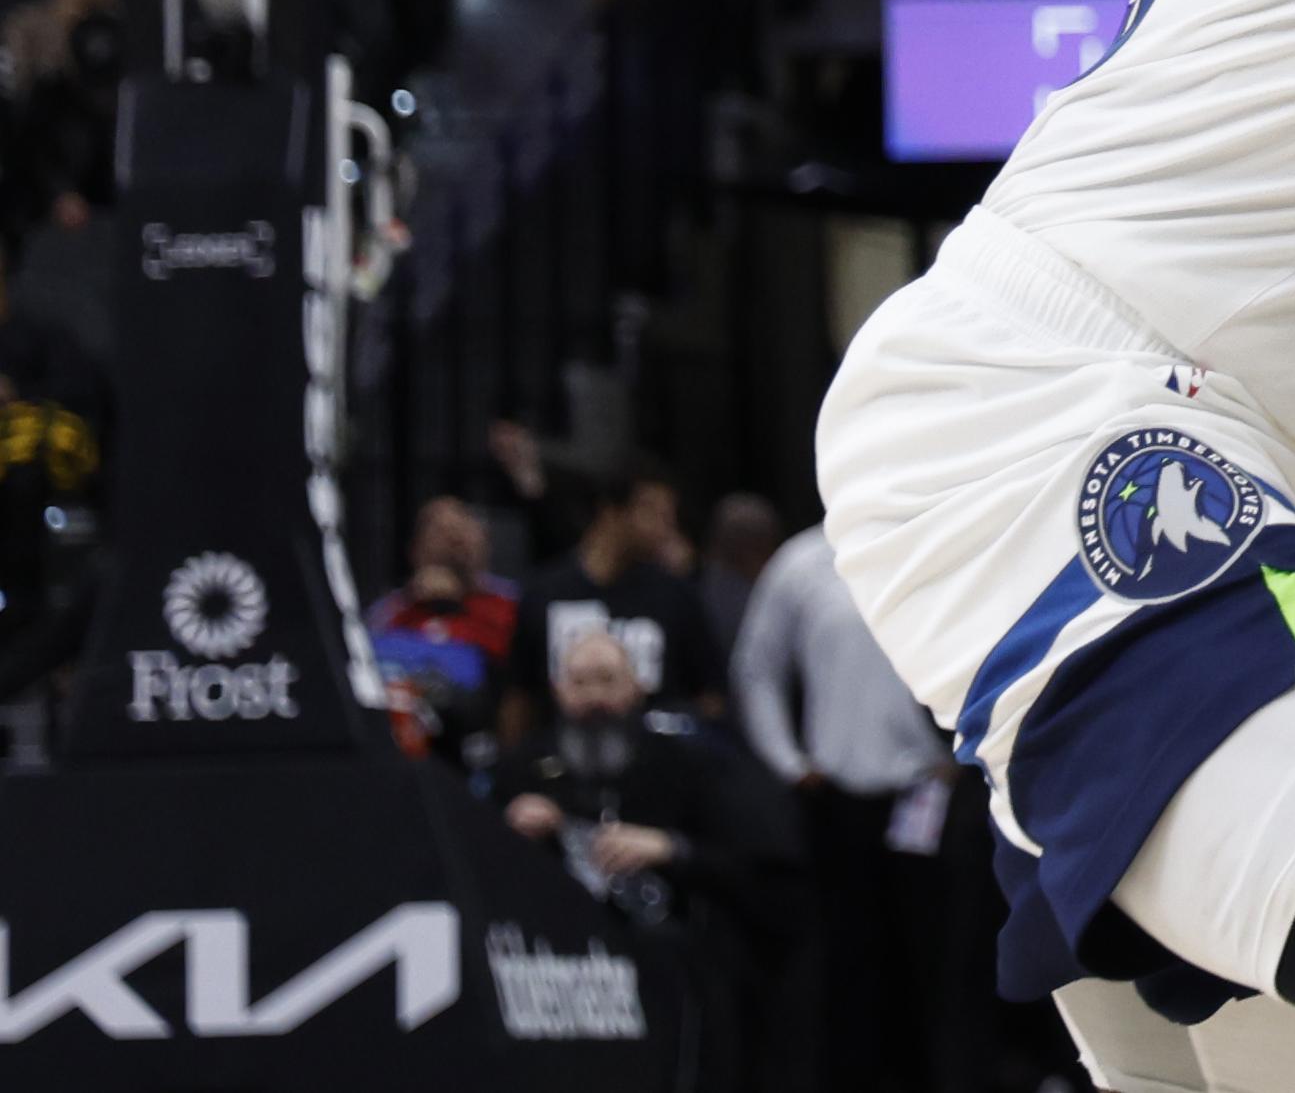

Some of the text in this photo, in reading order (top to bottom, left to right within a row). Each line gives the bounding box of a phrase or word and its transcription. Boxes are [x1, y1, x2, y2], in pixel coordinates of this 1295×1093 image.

[1080, 432, 1259, 586] MINNESOTA TIMBERWOLVES
[126, 650, 301, 722] Frost
